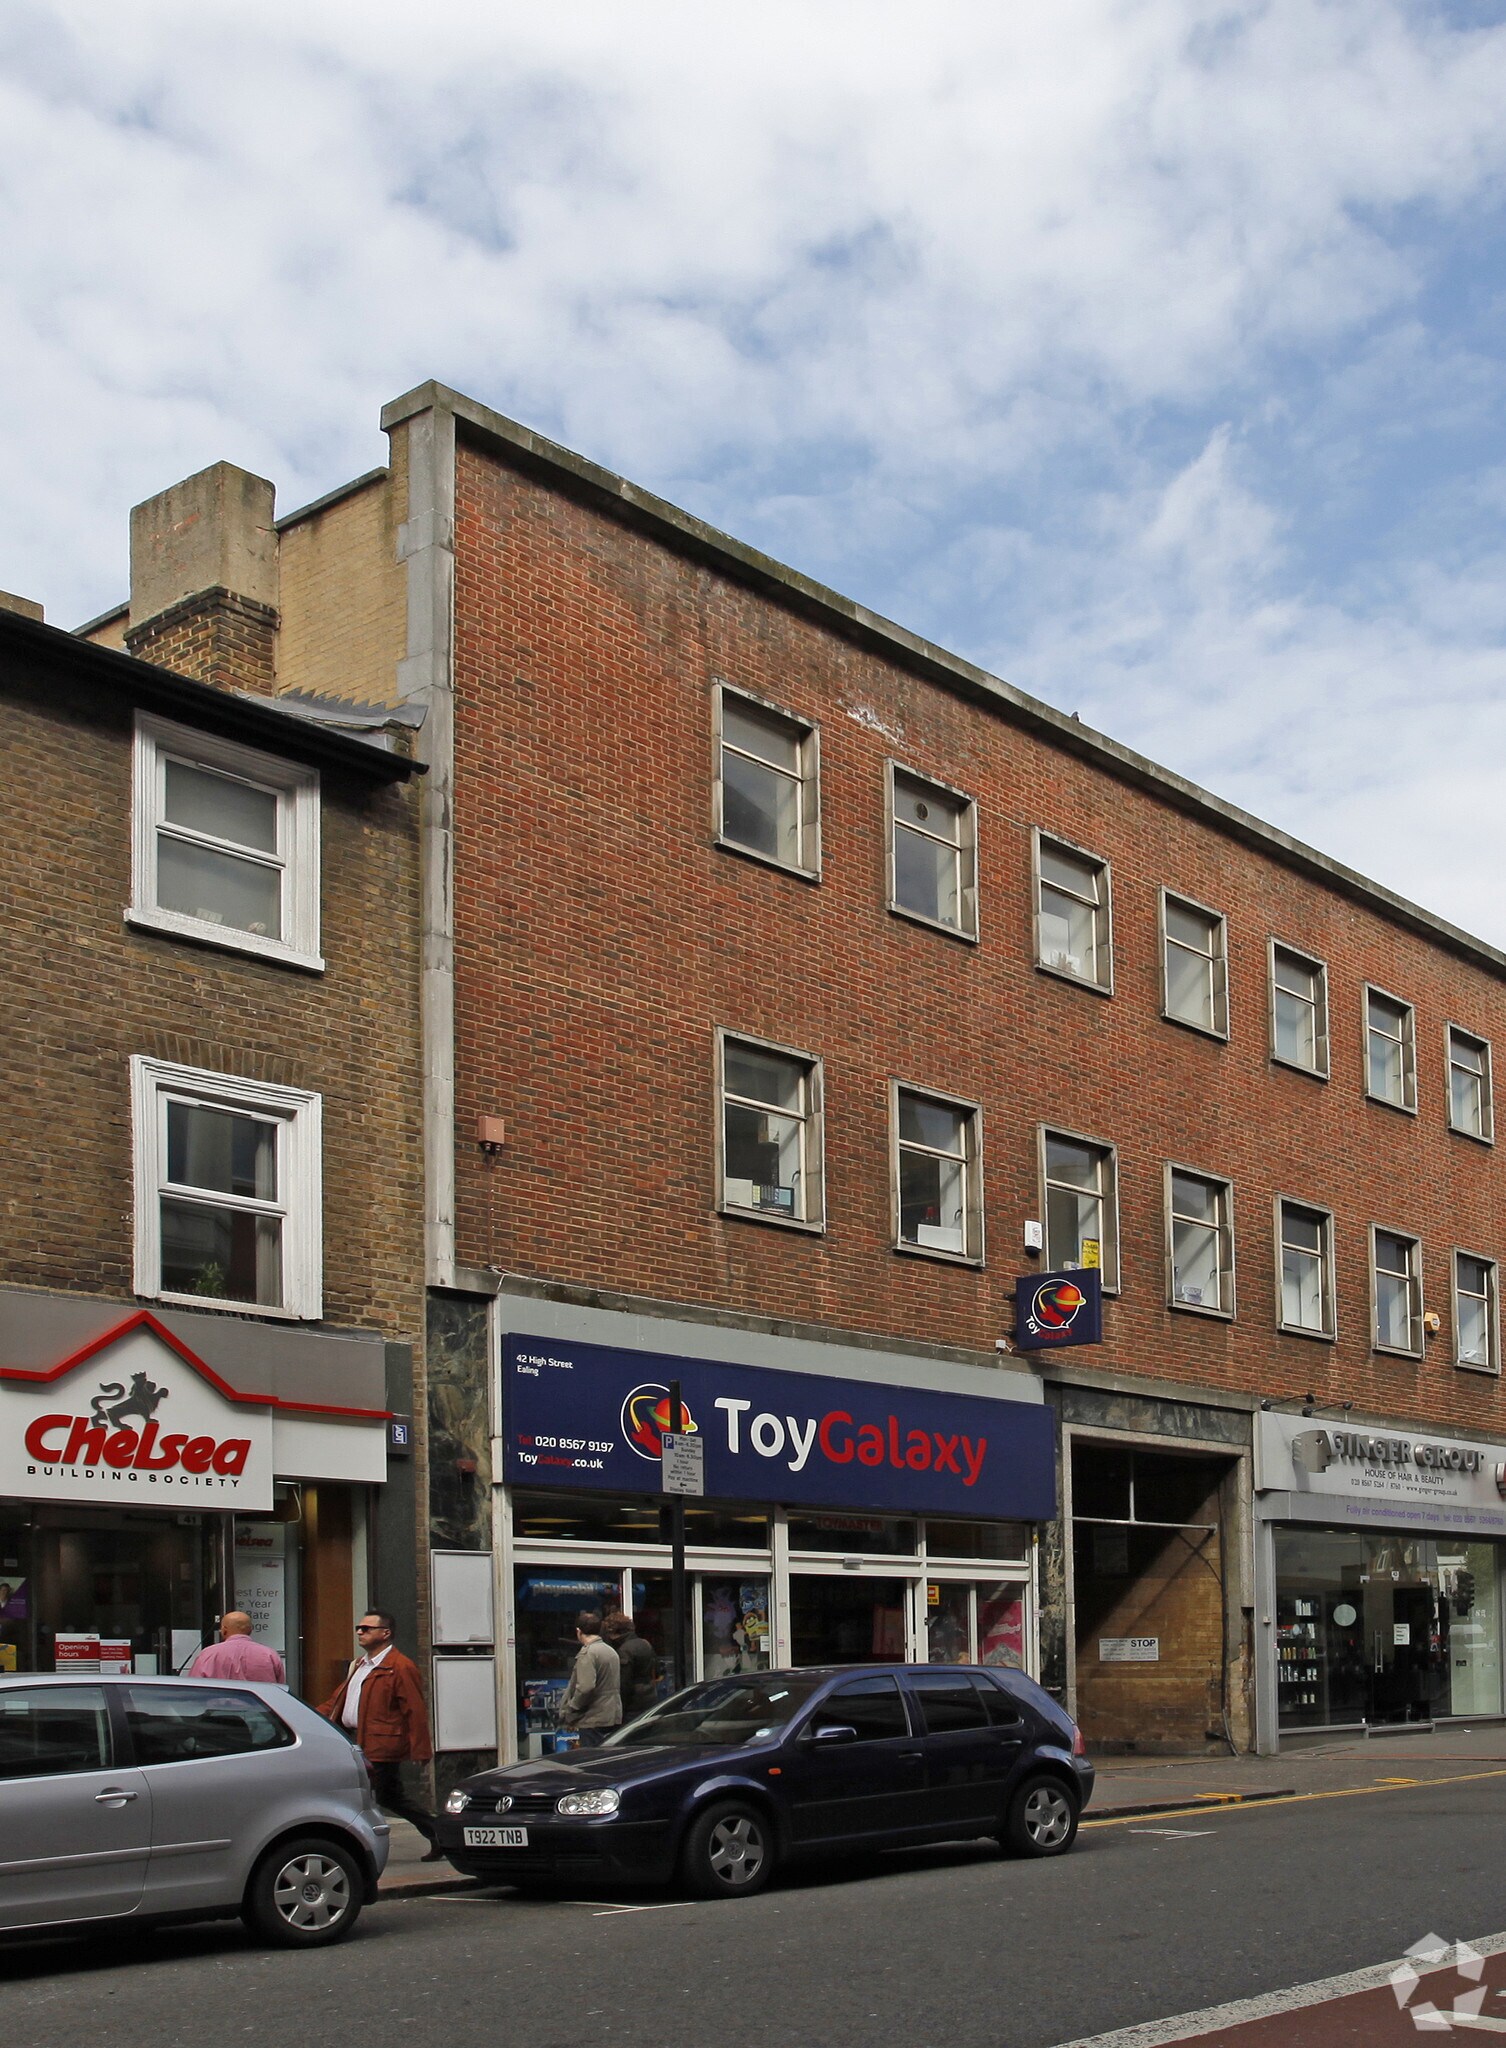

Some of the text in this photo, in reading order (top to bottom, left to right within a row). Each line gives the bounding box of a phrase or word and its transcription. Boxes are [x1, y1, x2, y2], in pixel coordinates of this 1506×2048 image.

[516, 1354, 574, 1369] 42 High Street
[517, 1365, 539, 1376] Ealing
[24, 1413, 252, 1477] Chelsea
[535, 1436, 557, 1447] 020
[559, 1438, 586, 1450] 8567
[588, 1441, 614, 1452] 9197
[665, 1436, 673, 1448] P
[714, 1397, 987, 1487] ToyGalaxy
[1331, 1432, 1487, 1472] GINGER GROUP
[27, 1465, 240, 1488] BUILDING SOCIETY
[1364, 1468, 1445, 1486] HOUSE OF HAIR & BEAUTY
[1346, 1504, 1363, 1517] Fully
[1362, 1507, 1371, 1516] air
[1371, 1507, 1406, 1519] conditioned
[1406, 1511, 1421, 1521] open
[1426, 1512, 1440, 1522] days
[236, 1588, 279, 1598] est Ever
[532, 1582, 594, 1597] playmobil
[249, 1599, 272, 1609] Year
[58, 1643, 90, 1652] Opening
[1130, 1639, 1156, 1647] STOP
[467, 1830, 523, 1844] T922 TNB
